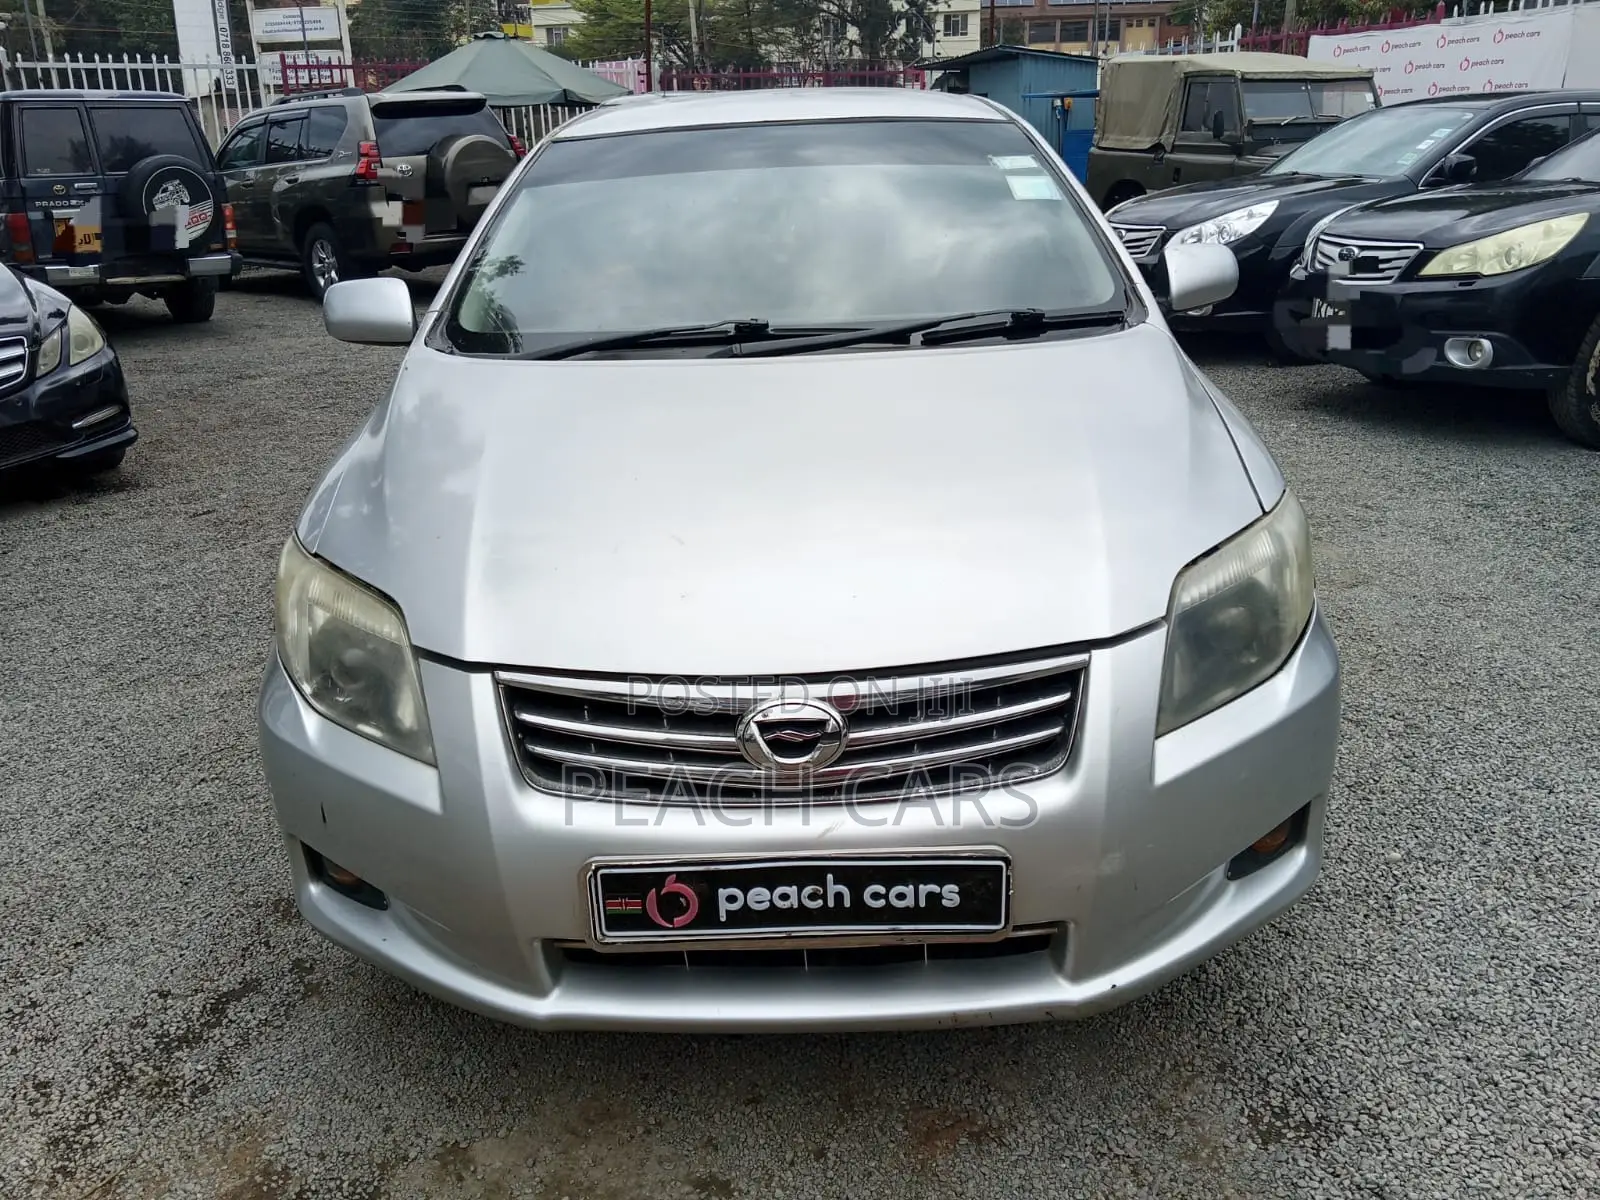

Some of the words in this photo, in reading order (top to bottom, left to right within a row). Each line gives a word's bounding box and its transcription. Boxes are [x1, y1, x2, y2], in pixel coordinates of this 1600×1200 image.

[1504, 31, 1526, 41] peach
[1526, 30, 1541, 38] cars
[1391, 42, 1409, 51] peach
[1447, 36, 1466, 47] peach
[1342, 45, 1359, 55] peach
[219, 27, 230, 49] 0718
[225, 69, 235, 85] 333
[1414, 62, 1432, 71] peach
[1471, 59, 1490, 69] peach
[1438, 84, 1457, 93] peach
[1494, 80, 1514, 90] peach
[1514, 80, 1529, 88] cars
[1383, 87, 1401, 95] peach
[718, 873, 851, 922] peach
[863, 884, 960, 908] cars
